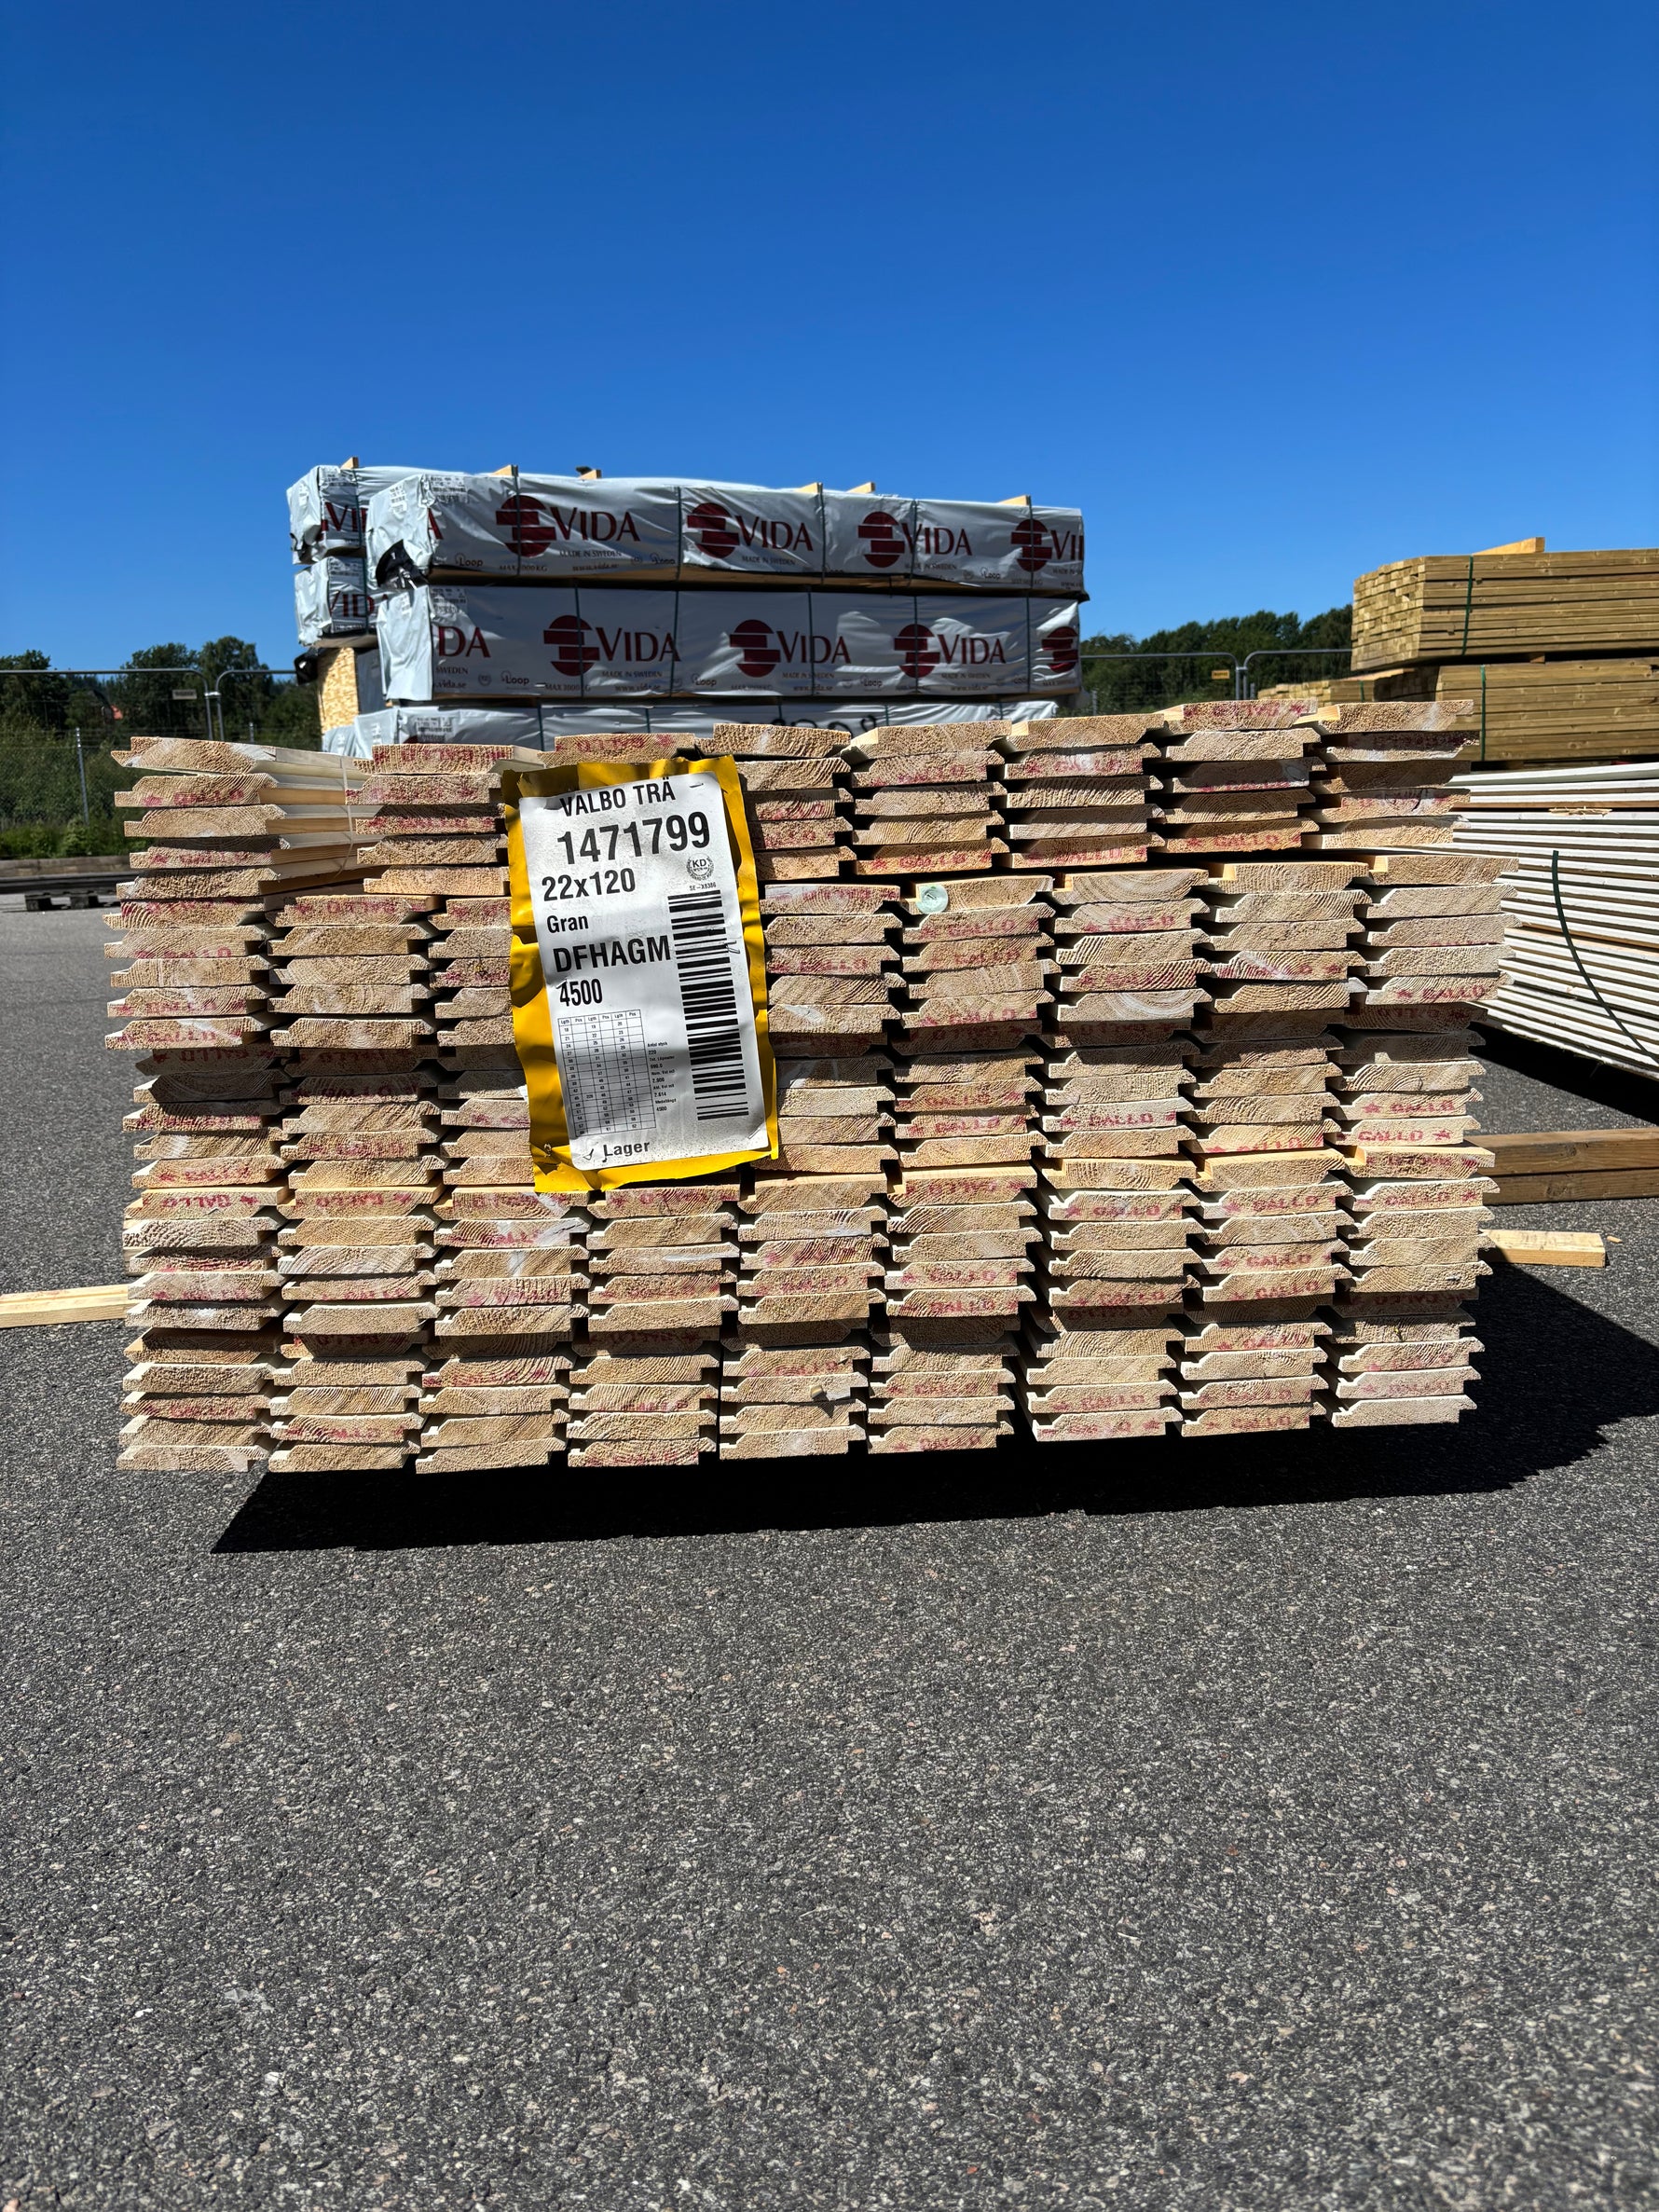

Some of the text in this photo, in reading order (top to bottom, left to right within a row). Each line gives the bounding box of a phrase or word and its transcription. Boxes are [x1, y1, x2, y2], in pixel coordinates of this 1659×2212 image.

[550, 506, 640, 542] VIDA
[734, 515, 814, 552] VIDA
[901, 522, 973, 556] VIDA
[596, 626, 680, 663] VIDA
[776, 630, 852, 665] VIDA
[937, 633, 1007, 666] VIDA
[505, 675, 529, 686] Loop
[560, 777, 676, 817] VALBO TRÄ
[557, 811, 710, 865] 1471799
[692, 859, 706, 868] KD
[542, 868, 636, 901] 22x120
[546, 914, 589, 933] Gran
[553, 935, 671, 972] DFHAGM
[559, 979, 603, 1006] 4500
[603, 1142, 650, 1157] Lager
